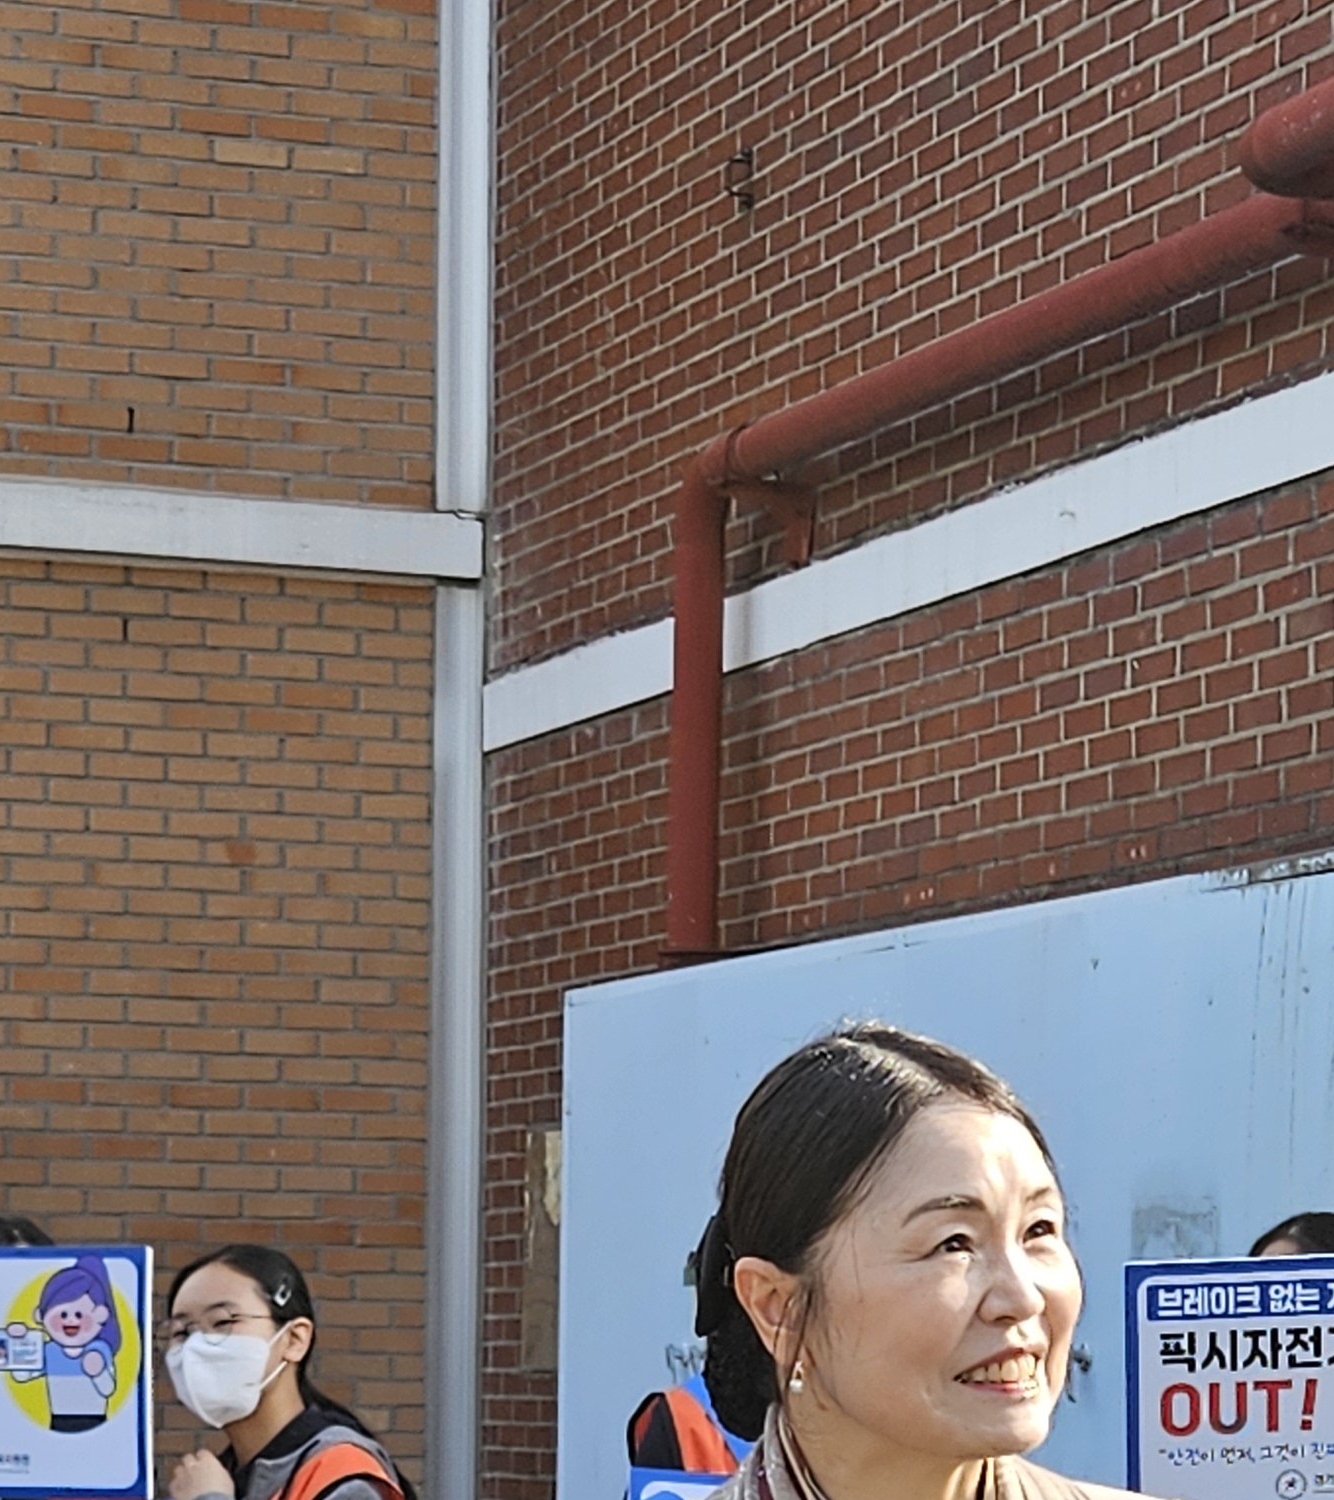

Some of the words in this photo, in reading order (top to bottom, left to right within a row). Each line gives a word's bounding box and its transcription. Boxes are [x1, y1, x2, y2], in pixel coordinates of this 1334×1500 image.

[1157, 1285, 1262, 1317] 브레이크
[1269, 1282, 1321, 1313] 없는
[1159, 1378, 1319, 1438] OUT!
[1260, 1443, 1306, 1461] 그것이
